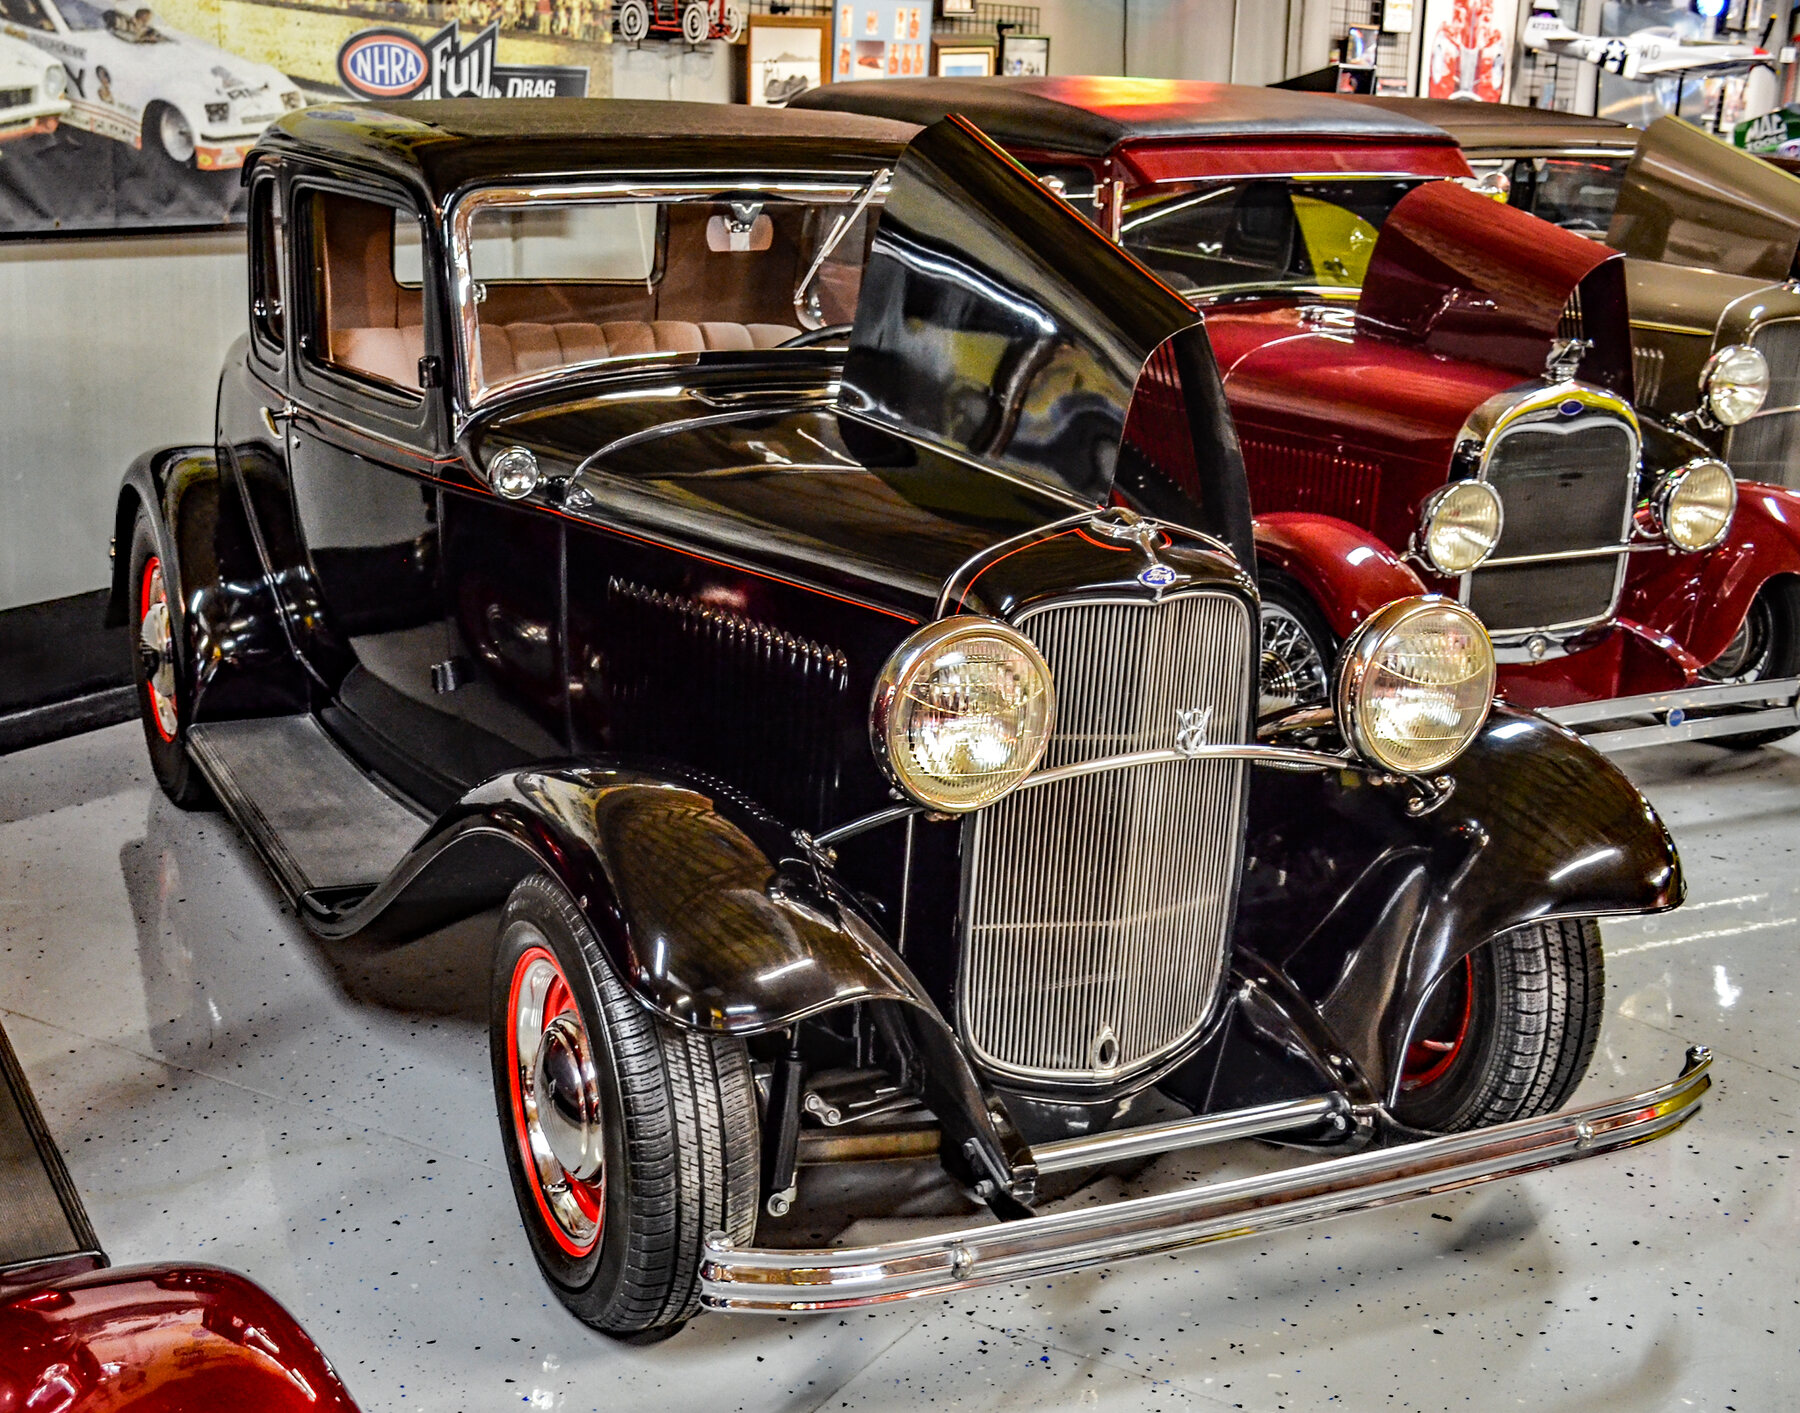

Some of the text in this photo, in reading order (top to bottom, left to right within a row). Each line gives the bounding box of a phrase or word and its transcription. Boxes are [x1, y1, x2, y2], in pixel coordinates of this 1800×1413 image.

[356, 45, 418, 85] NHRA
[506, 77, 557, 98] DRAG
[1744, 113, 1788, 143] MAC
